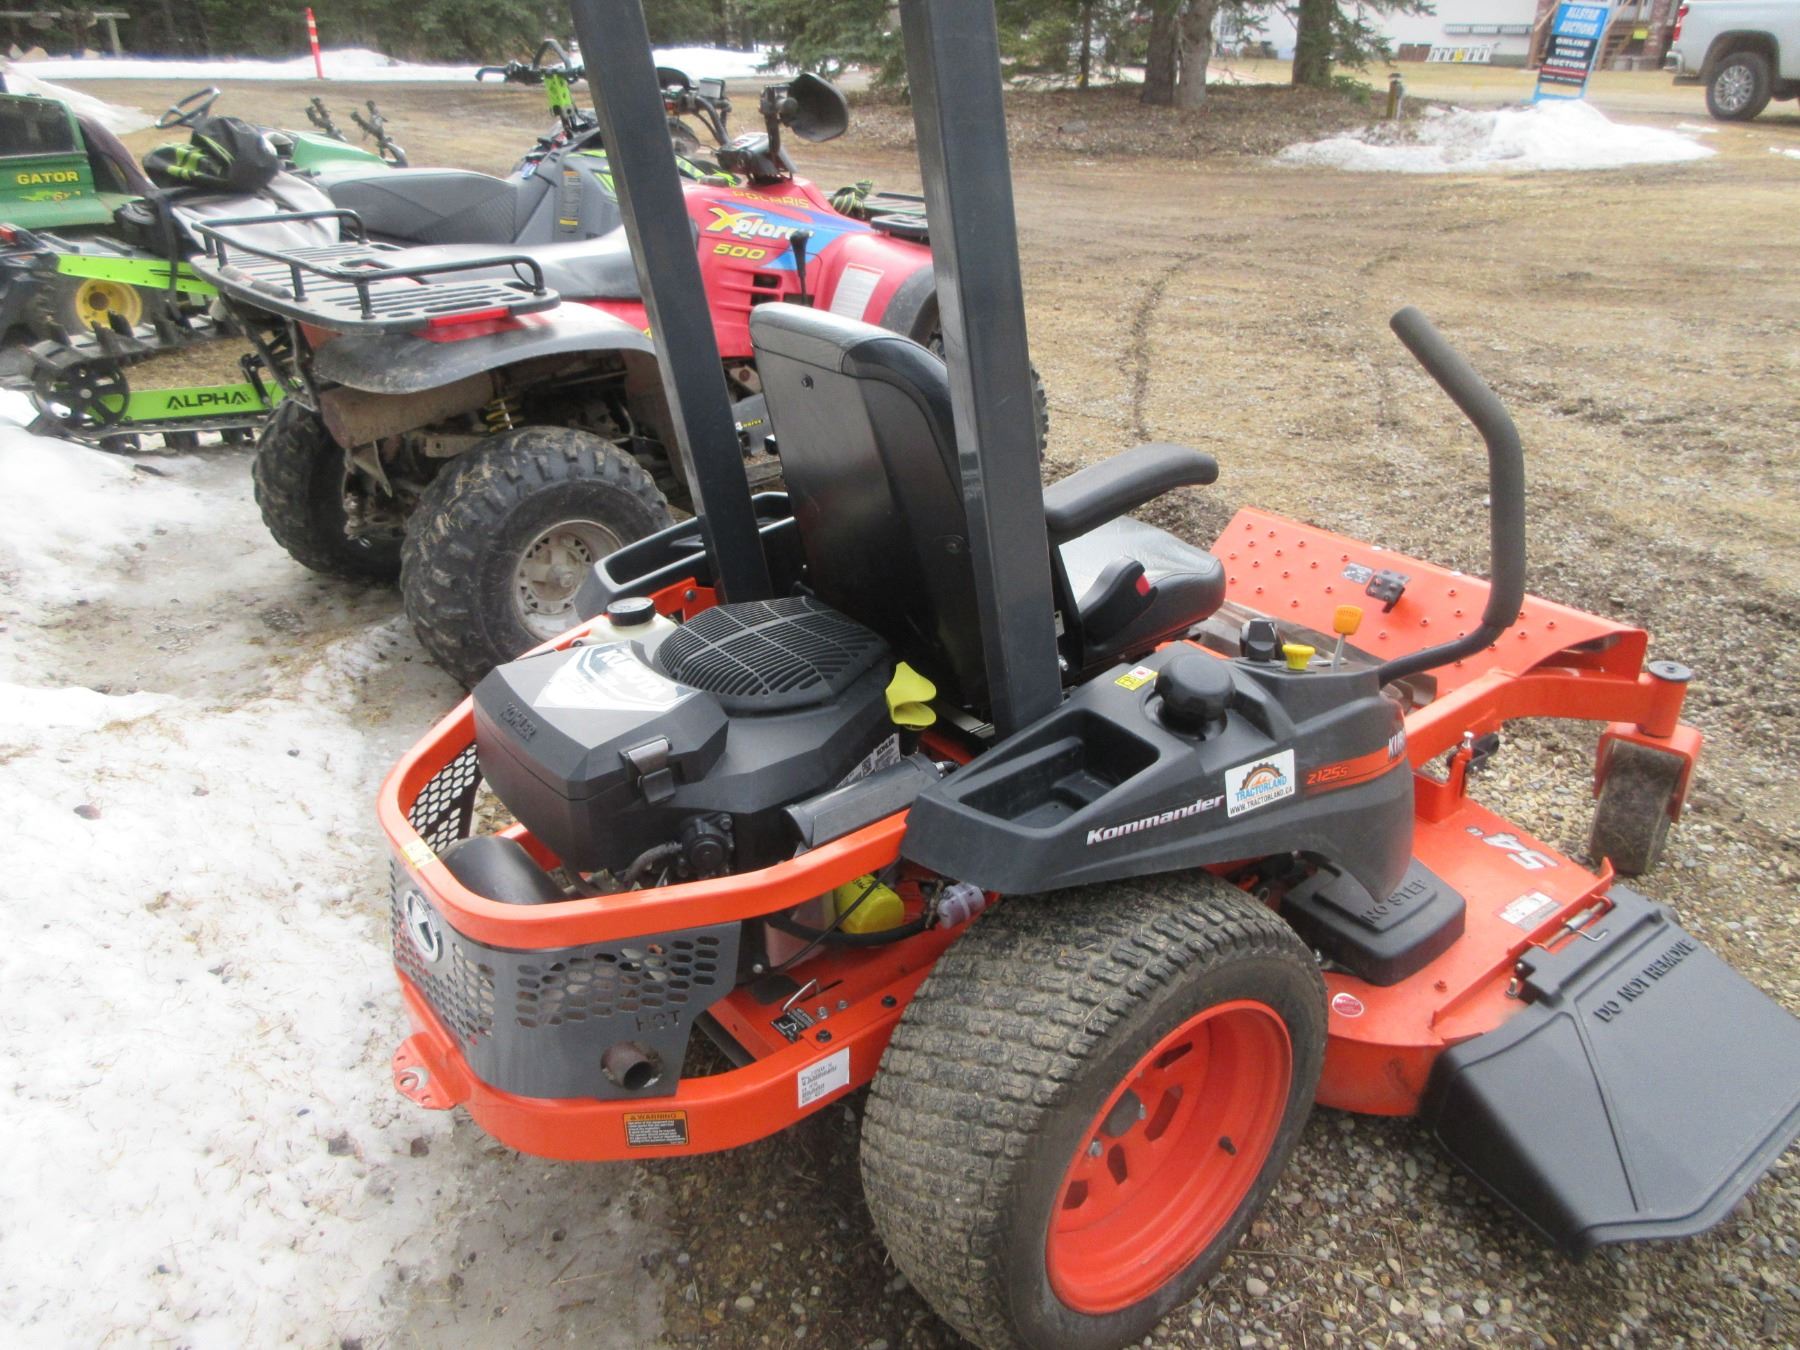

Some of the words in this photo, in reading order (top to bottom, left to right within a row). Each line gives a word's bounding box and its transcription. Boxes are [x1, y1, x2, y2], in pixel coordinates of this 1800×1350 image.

[1555, 37, 1591, 47] ONLINE
[1555, 48, 1585, 57] TIMED
[1546, 58, 1586, 69] AUCTION
[16, 171, 79, 185] GATOR
[731, 190, 810, 209] POLARIS
[712, 243, 767, 260] 500
[166, 391, 248, 410] ALPHA
[500, 702, 537, 741] KOHLER
[1235, 775, 1288, 802] TRACTORLAND
[1229, 786, 1293, 815] WWW.TRACTORLAND.CA
[1086, 794, 1225, 846] Kommander
[1360, 902, 1391, 924] NO
[1386, 879, 1428, 906] STEP
[1592, 1000, 1623, 1023] DO
[1616, 976, 1651, 1002] NOT
[1641, 938, 1698, 981] REMOVE
[634, 1008, 681, 1032] HOT
[636, 1112, 677, 1121] WARNING
